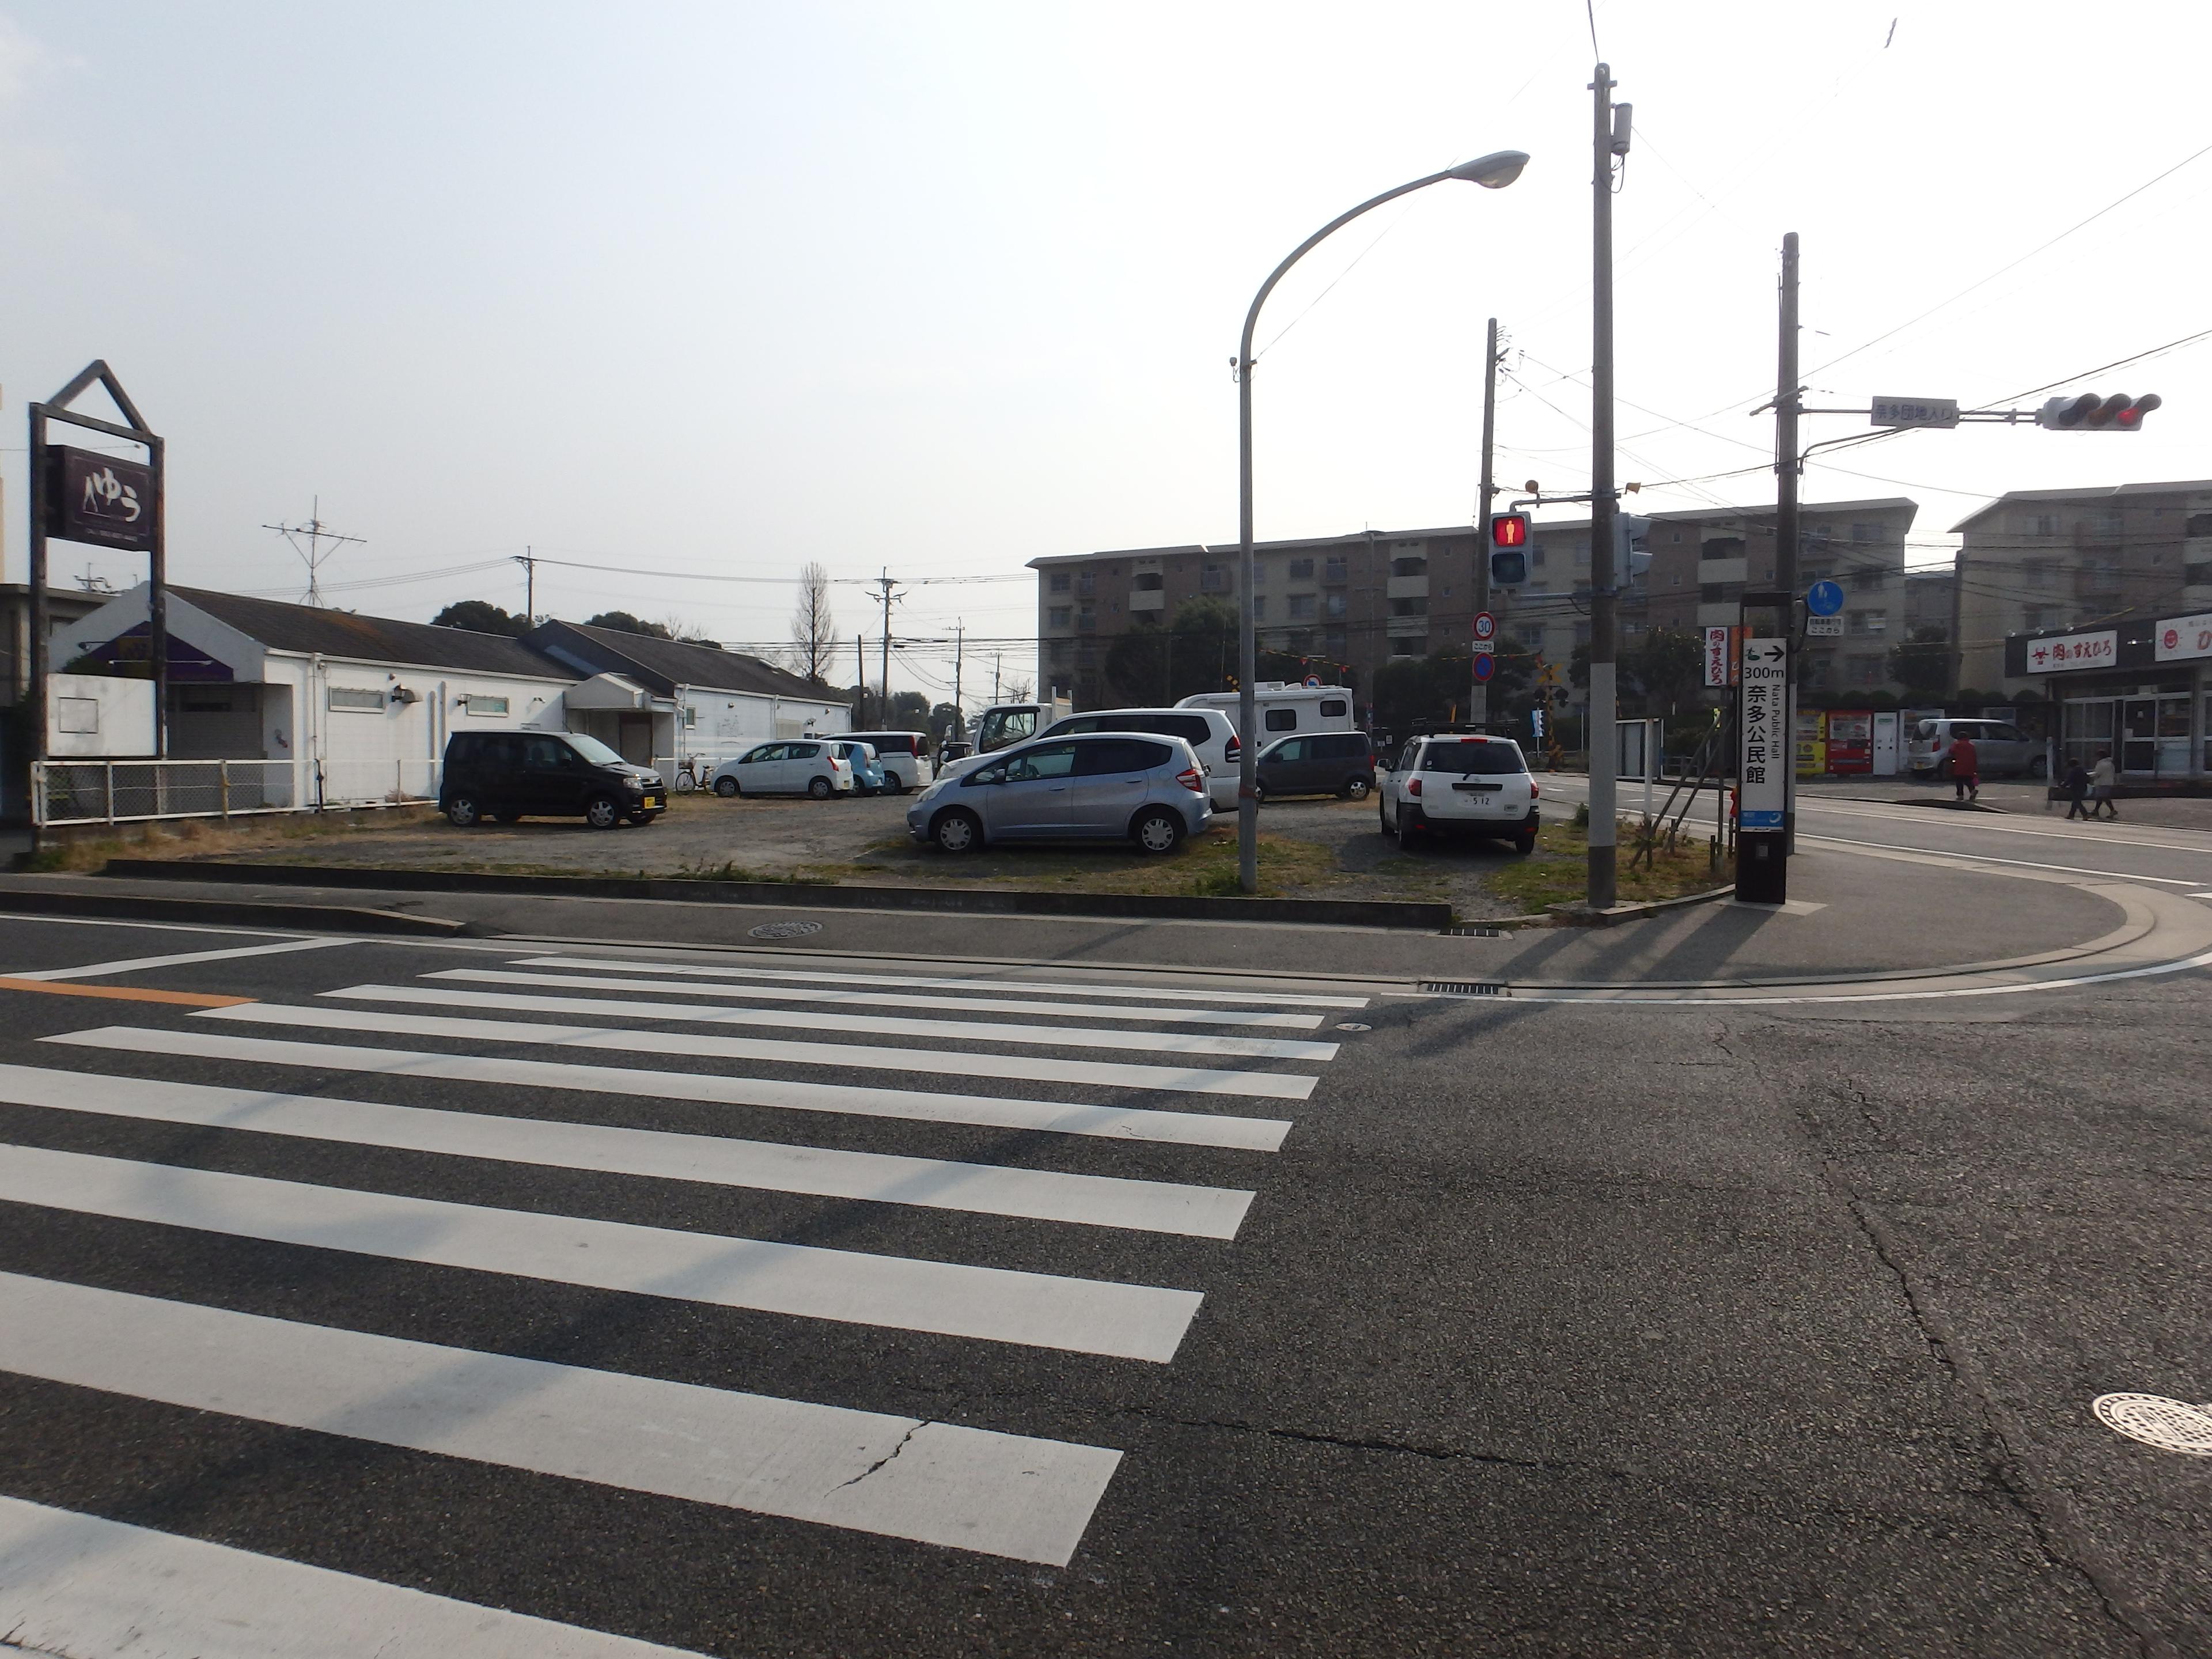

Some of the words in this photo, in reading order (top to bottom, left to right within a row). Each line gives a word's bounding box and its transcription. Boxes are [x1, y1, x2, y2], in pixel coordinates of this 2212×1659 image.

[1875, 404, 1953, 421] 奈多団地入口
[1478, 620, 1491, 632] 30
[1710, 630, 1725, 684] 肉のすえひろ
[2052, 639, 2112, 661] 肉のすえひろ
[1744, 667, 1784, 679] 300m
[1771, 684, 1781, 707] Nata
[1746, 685, 1767, 784] 奈多公民館
[1771, 710, 1781, 738] Public
[1771, 741, 1781, 759] Hall
